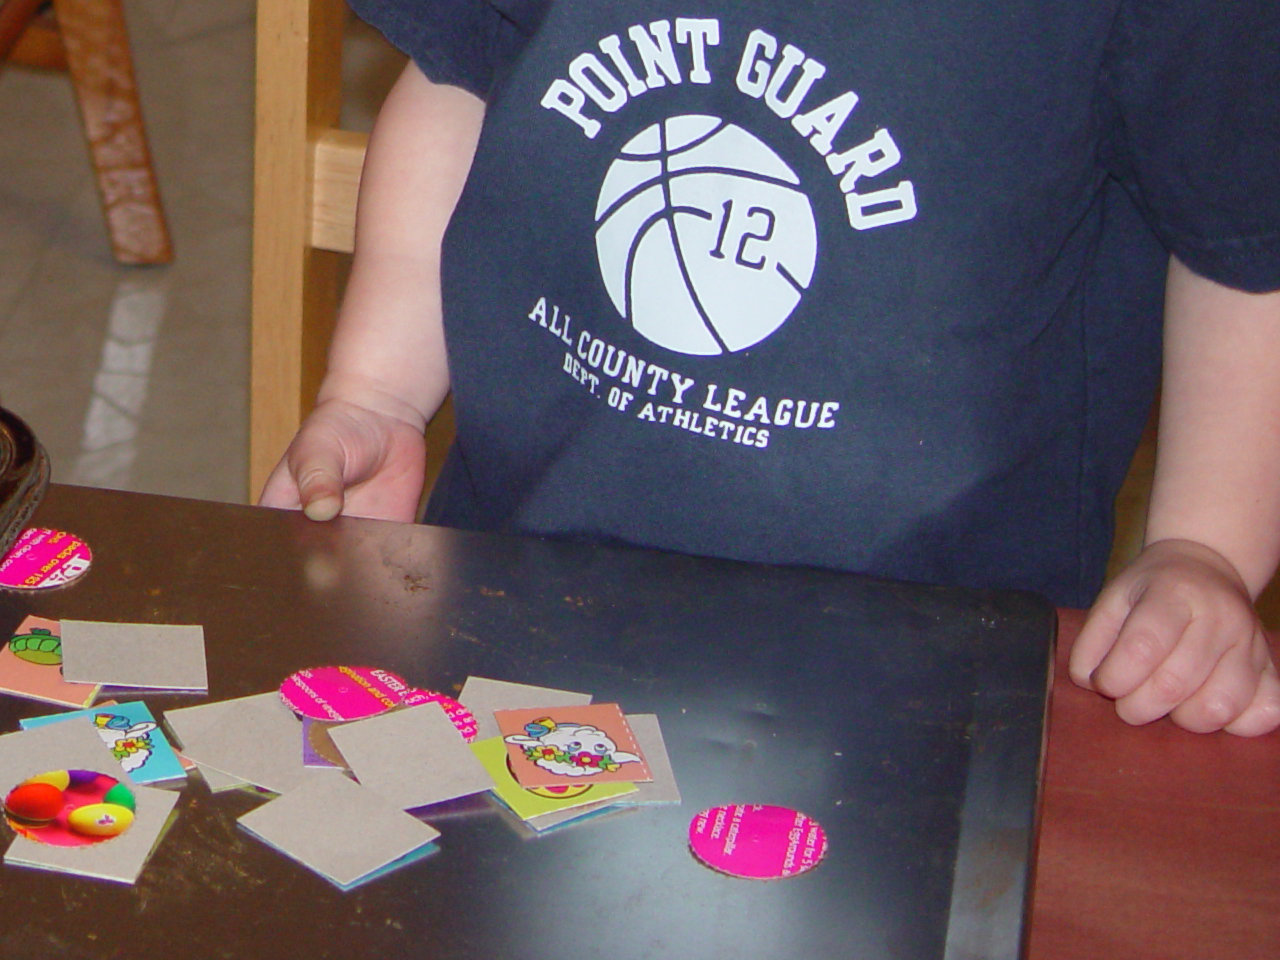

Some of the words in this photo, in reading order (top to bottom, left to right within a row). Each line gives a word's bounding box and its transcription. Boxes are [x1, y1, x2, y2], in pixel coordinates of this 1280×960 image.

[540, 17, 719, 139] POINT
[736, 28, 918, 231] GUARD
[709, 199, 776, 270] 12
[527, 297, 573, 345] ALL
[576, 328, 695, 405] COUNTY
[704, 383, 840, 429] LEAGUE
[563, 351, 601, 399] DEPT.
[608, 385, 634, 411] OF
[637, 404, 771, 448] ATHLETICS
[370, 669, 405, 694] EASTER
